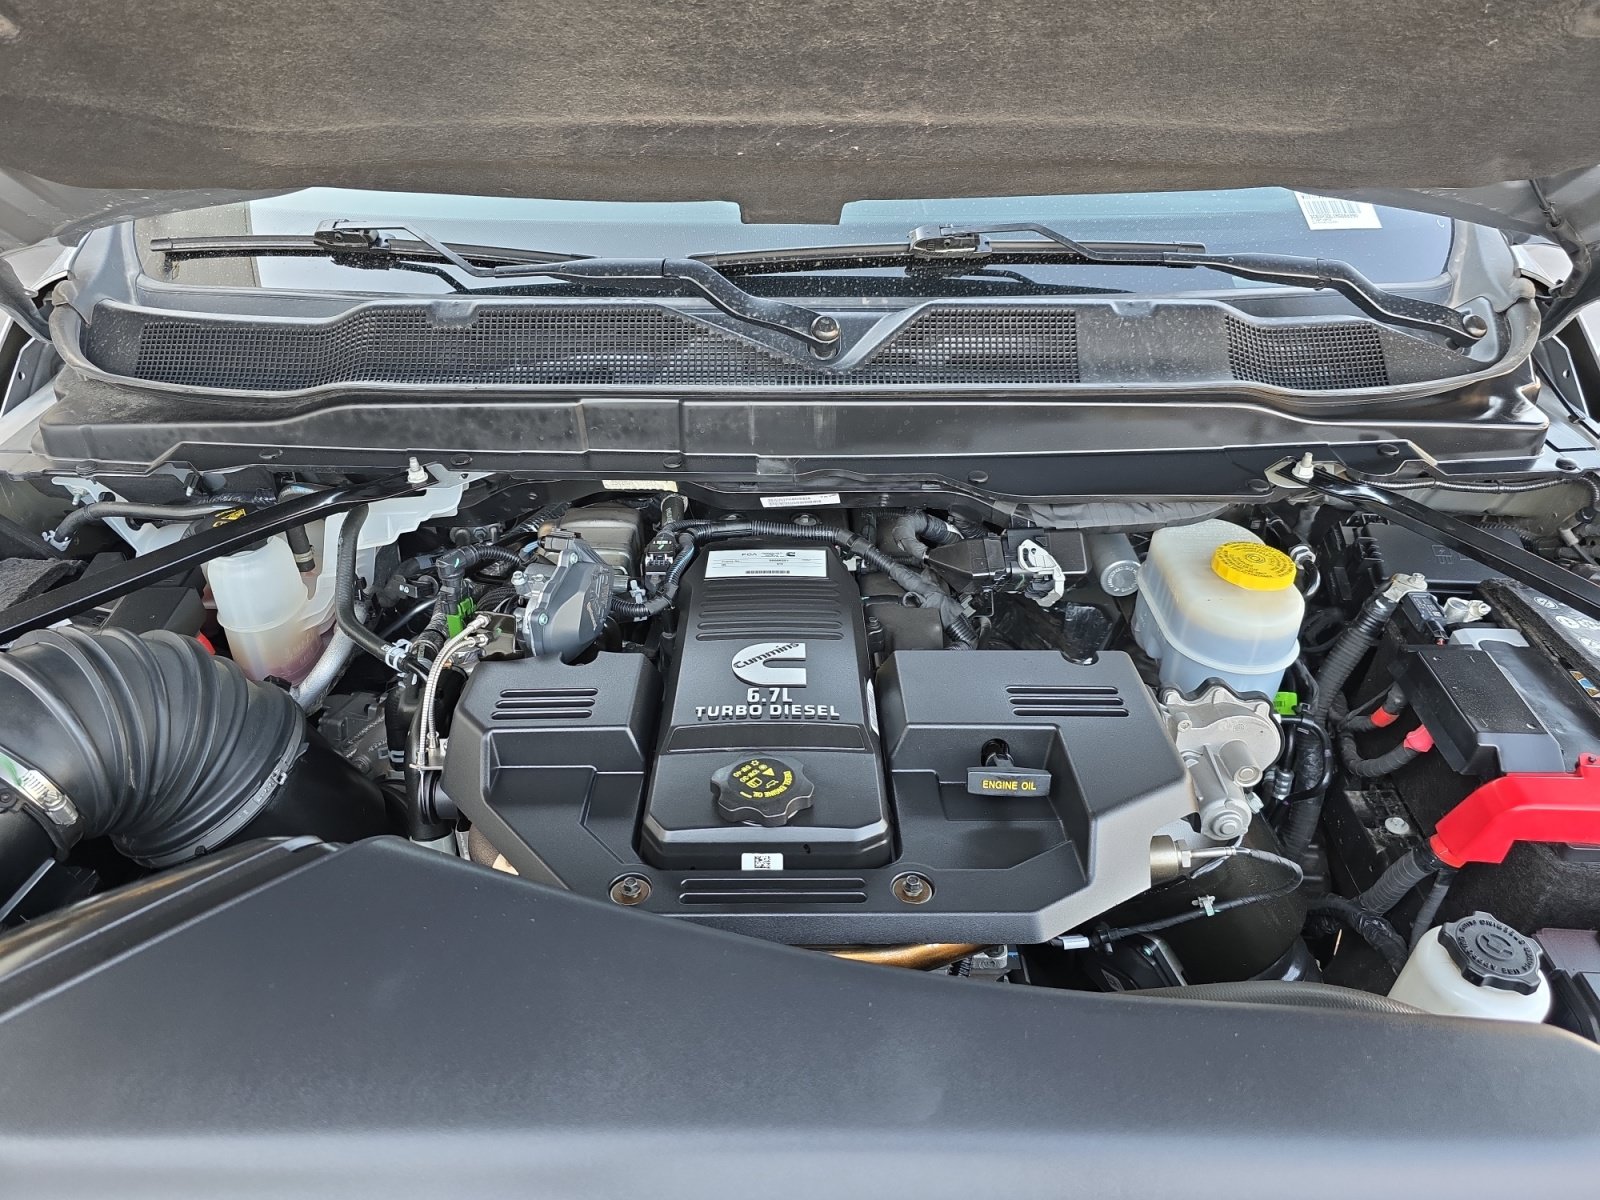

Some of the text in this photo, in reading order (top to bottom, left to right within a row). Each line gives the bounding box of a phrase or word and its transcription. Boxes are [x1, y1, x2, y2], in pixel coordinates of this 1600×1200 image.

[733, 642, 800, 669] Cummins
[747, 687, 793, 704] 6.7L
[696, 704, 840, 720] TURBO DIESEL
[982, 780, 1036, 791] ENGINE OIL
